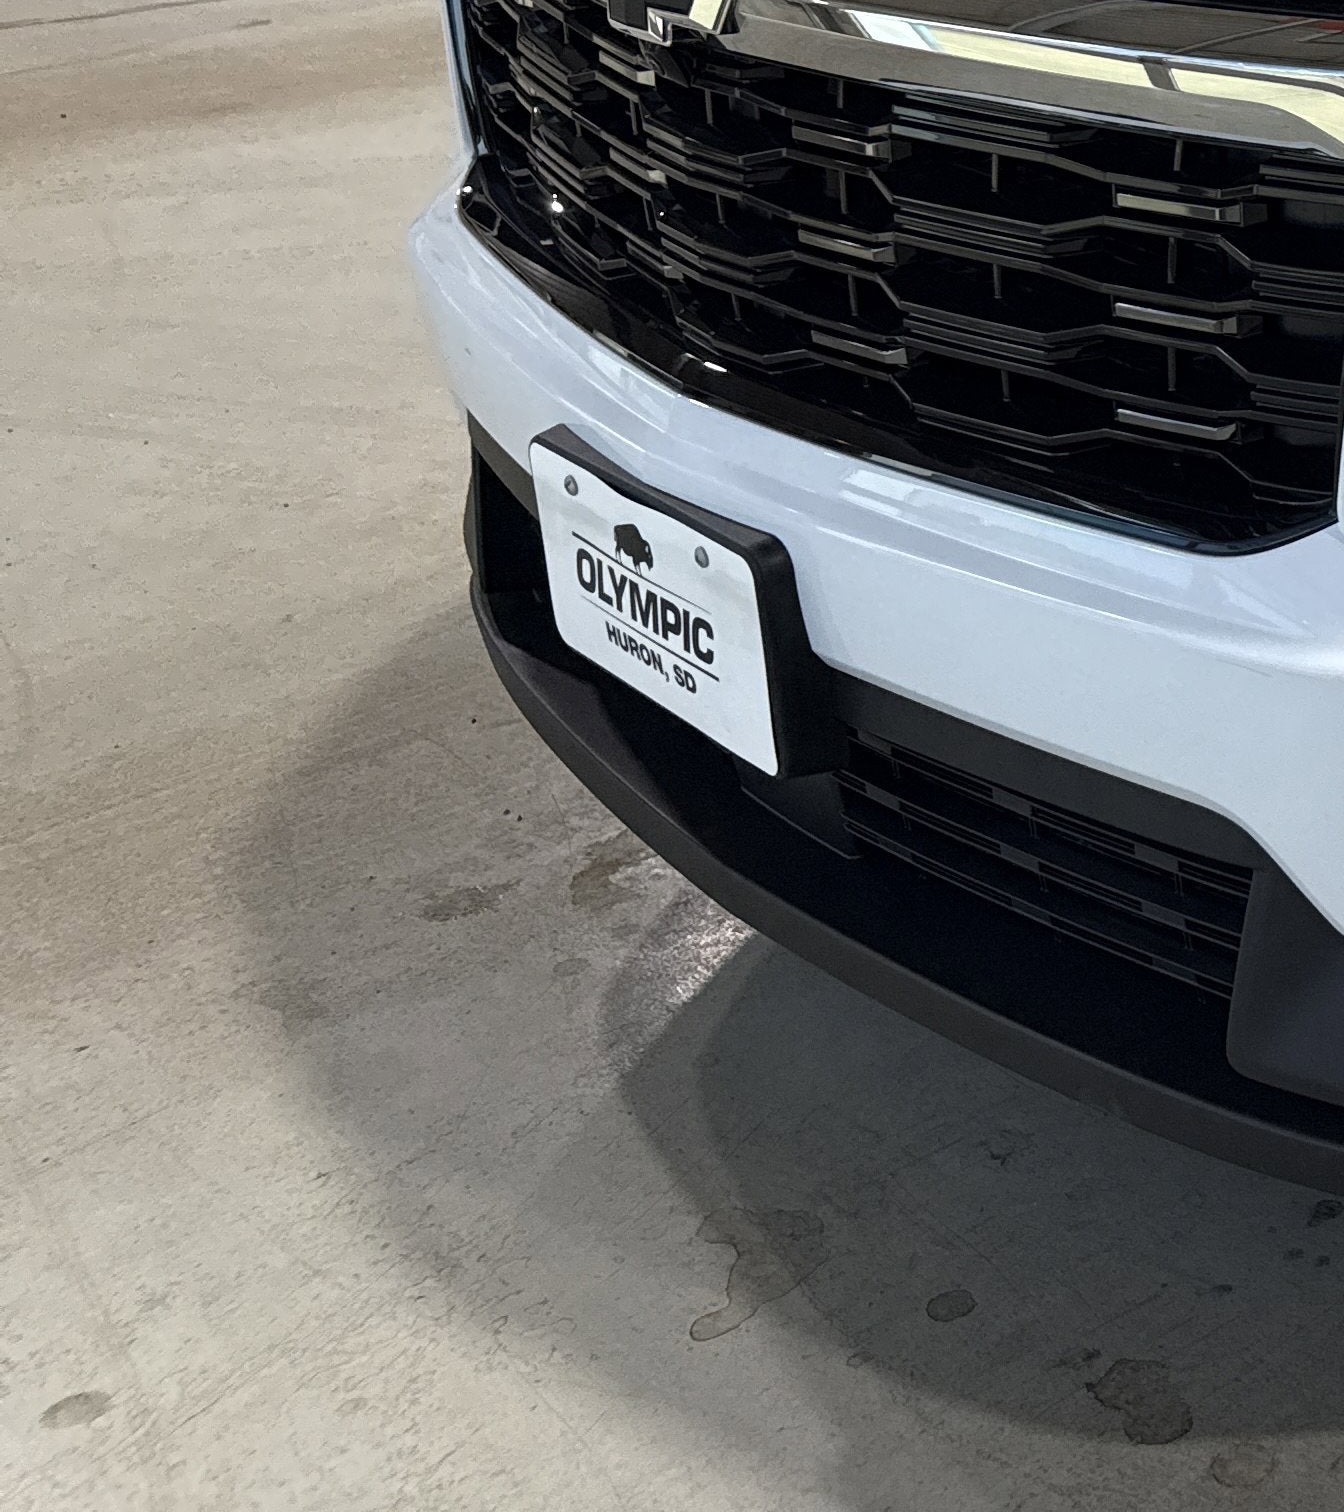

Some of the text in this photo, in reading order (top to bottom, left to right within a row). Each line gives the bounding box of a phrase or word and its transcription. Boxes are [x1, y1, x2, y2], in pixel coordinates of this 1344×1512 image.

[576, 548, 715, 666] OLYMPIC
[605, 620, 698, 695] HURON, SD
